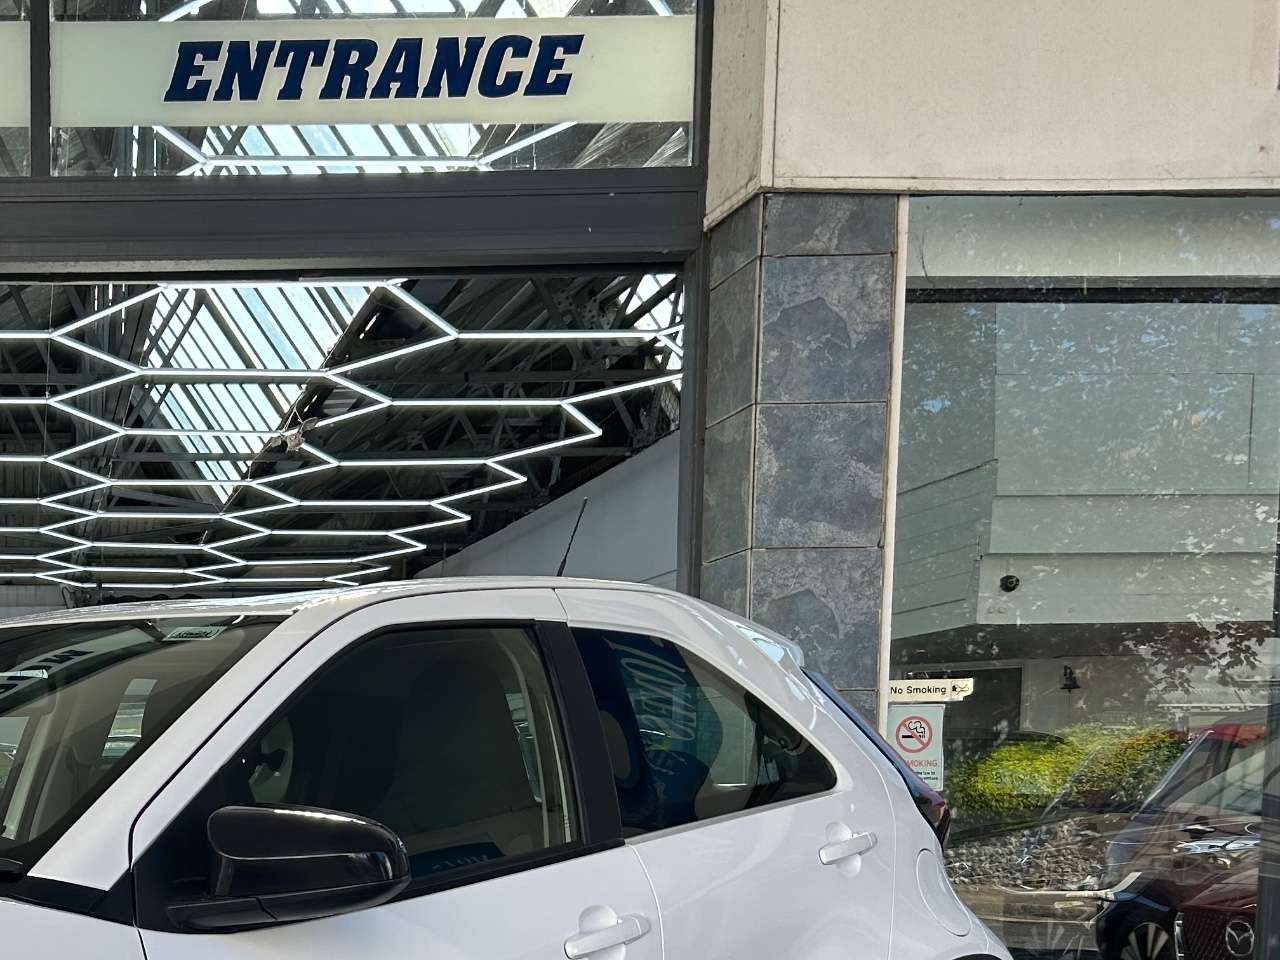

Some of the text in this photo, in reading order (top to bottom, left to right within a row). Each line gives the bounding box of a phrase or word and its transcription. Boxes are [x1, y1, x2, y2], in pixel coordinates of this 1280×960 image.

[163, 34, 585, 102] ENTRANCE
[890, 685, 947, 696] No Smoking
